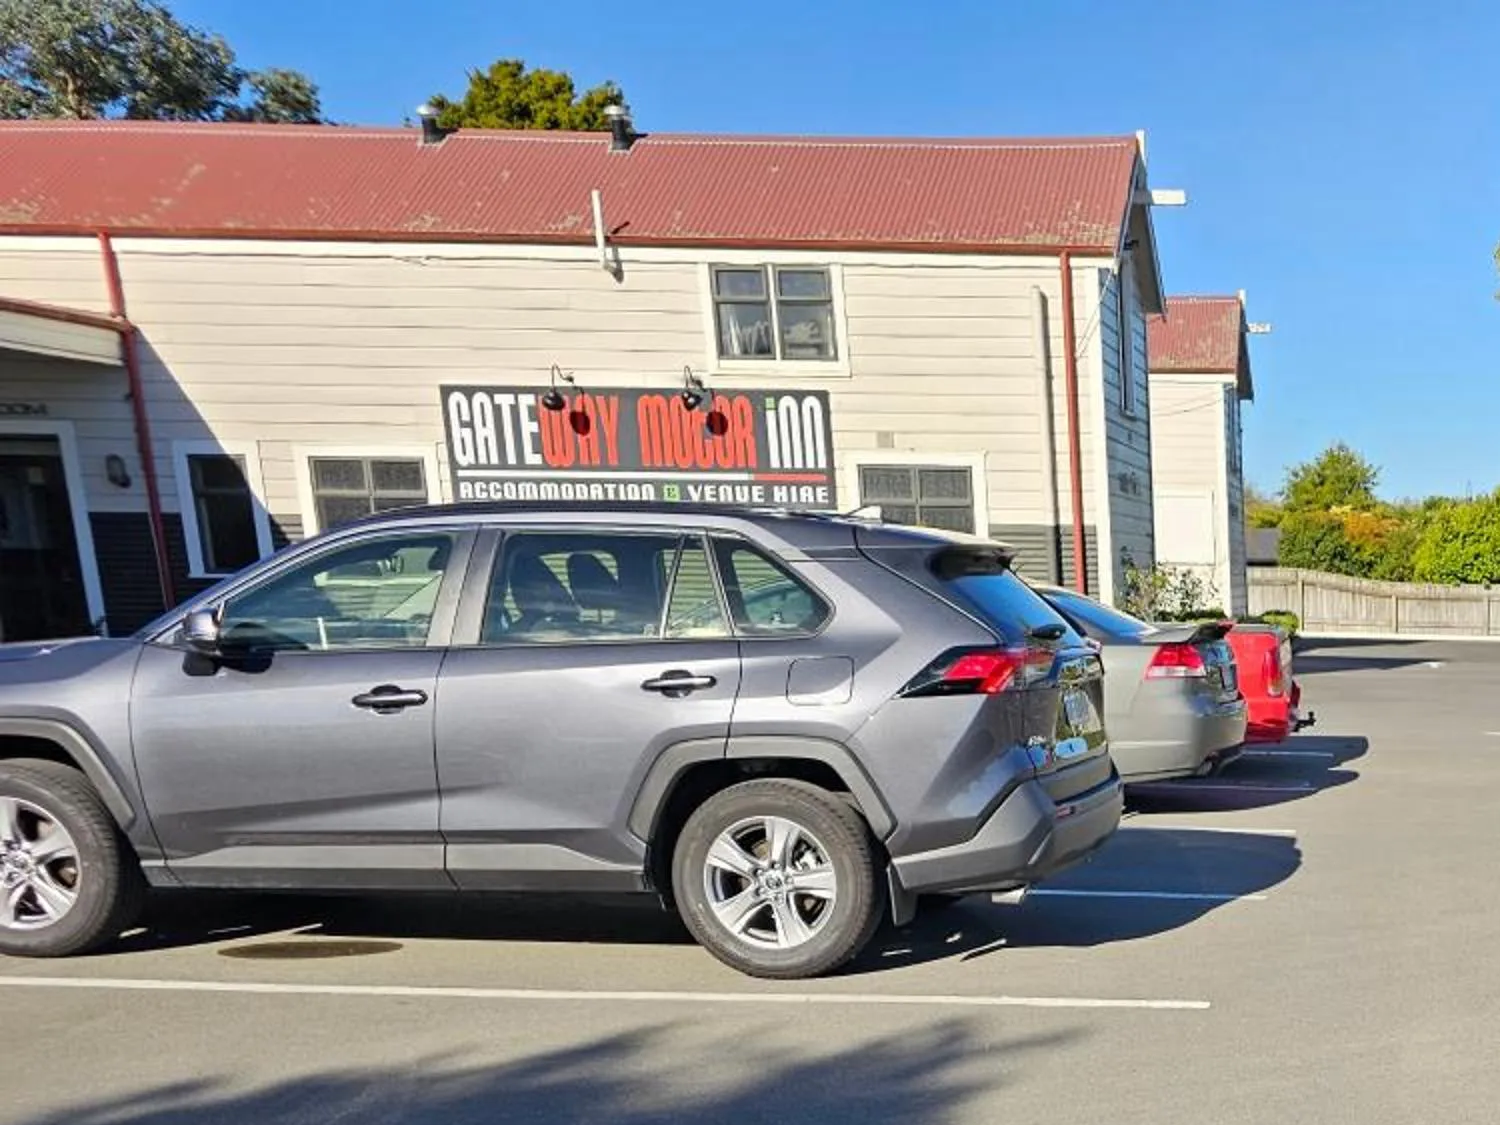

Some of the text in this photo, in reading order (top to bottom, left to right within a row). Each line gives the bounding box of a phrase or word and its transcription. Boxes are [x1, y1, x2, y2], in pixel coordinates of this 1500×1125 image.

[448, 391, 619, 468] GATEWAY
[459, 482, 656, 501] ACCOMMODATION
[687, 483, 765, 503] VENUE
[773, 484, 830, 504] HIRE
